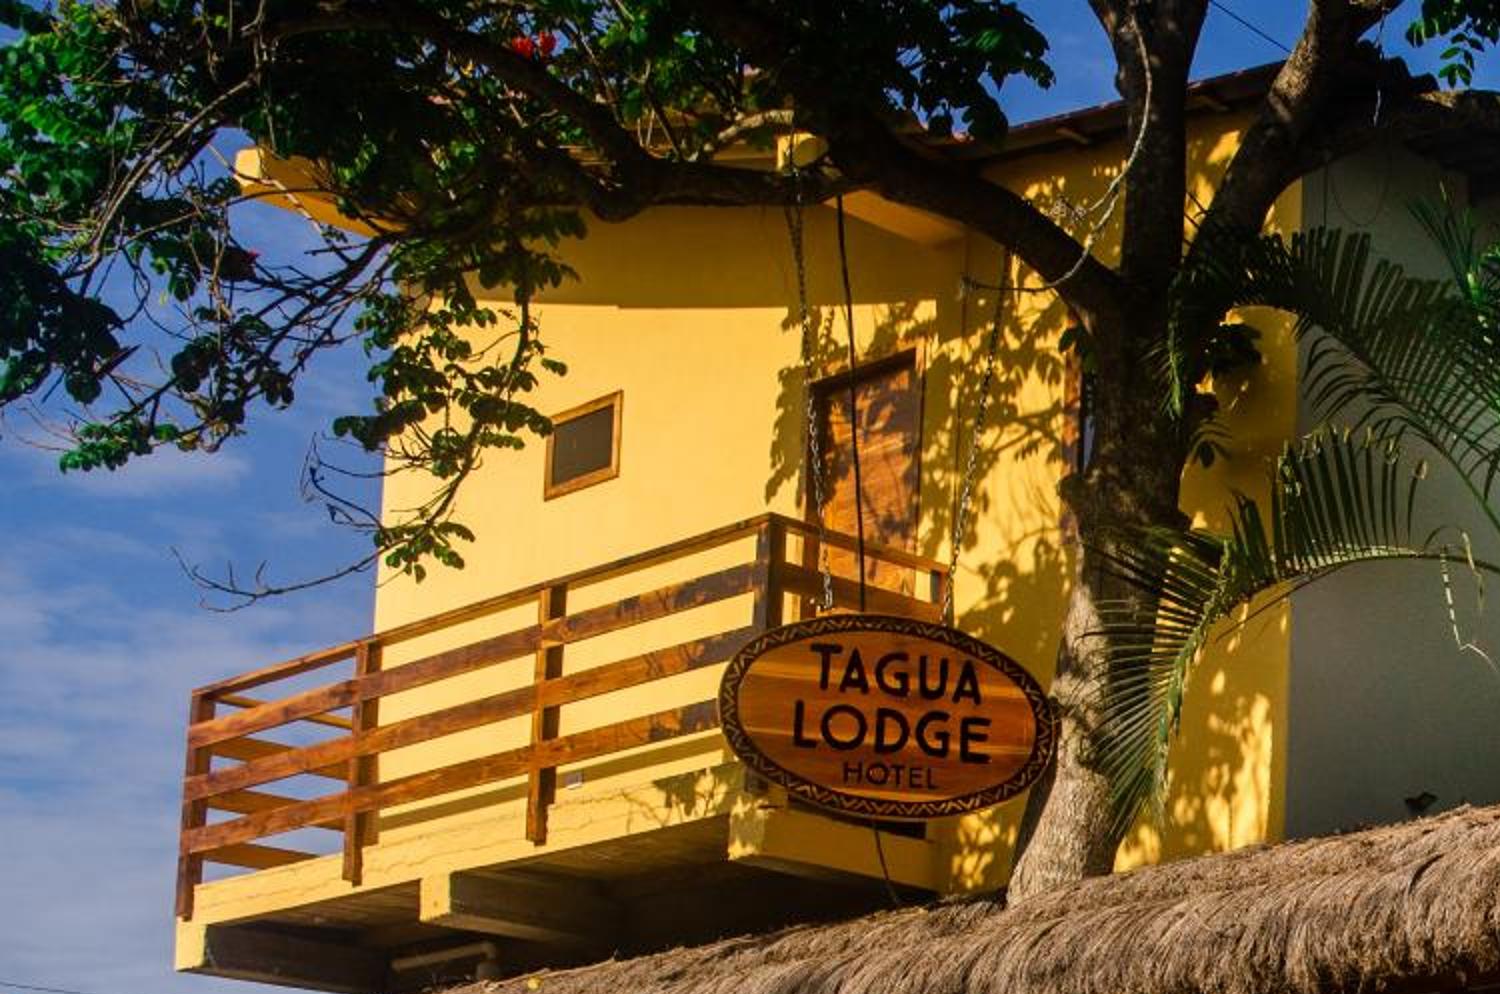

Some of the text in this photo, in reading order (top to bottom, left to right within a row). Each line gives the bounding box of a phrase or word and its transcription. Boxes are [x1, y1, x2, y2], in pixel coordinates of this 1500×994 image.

[810, 643, 981, 705] TAGUA
[793, 700, 993, 764] LODGE
[842, 761, 940, 789] HOTEL
